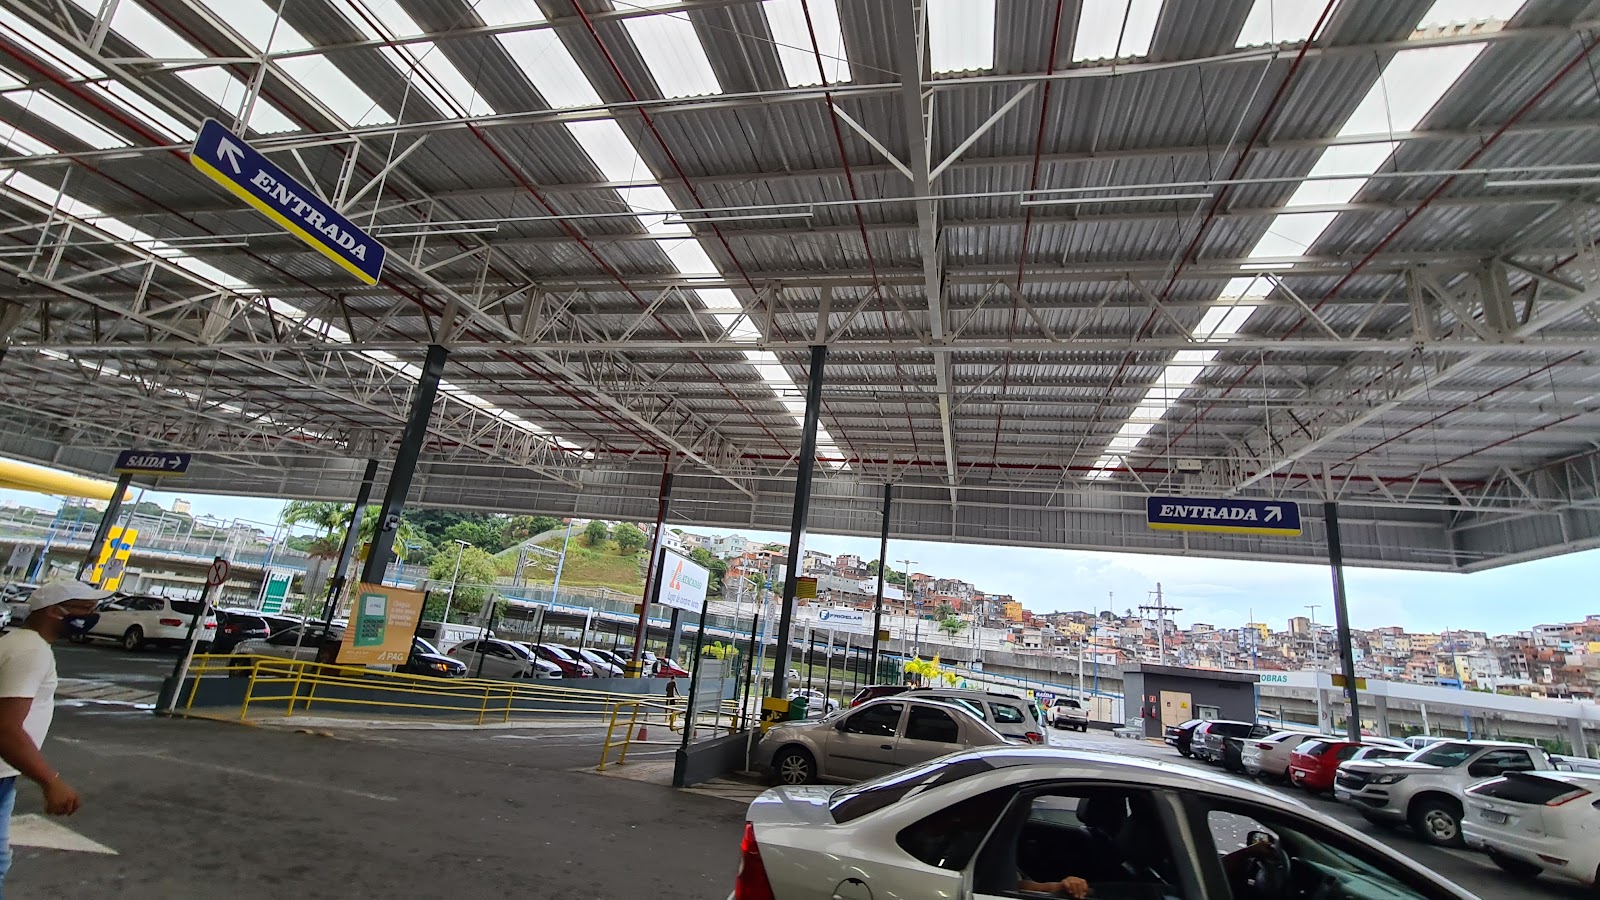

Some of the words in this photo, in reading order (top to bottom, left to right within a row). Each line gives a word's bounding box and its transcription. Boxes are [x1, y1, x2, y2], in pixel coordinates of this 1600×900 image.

[249, 168, 366, 262] ENTRADA
[125, 453, 166, 468] SAÍDA
[1159, 504, 1258, 521] ENTRADA
[387, 652, 403, 661] PAG
[1261, 674, 1288, 683] OBRAS
